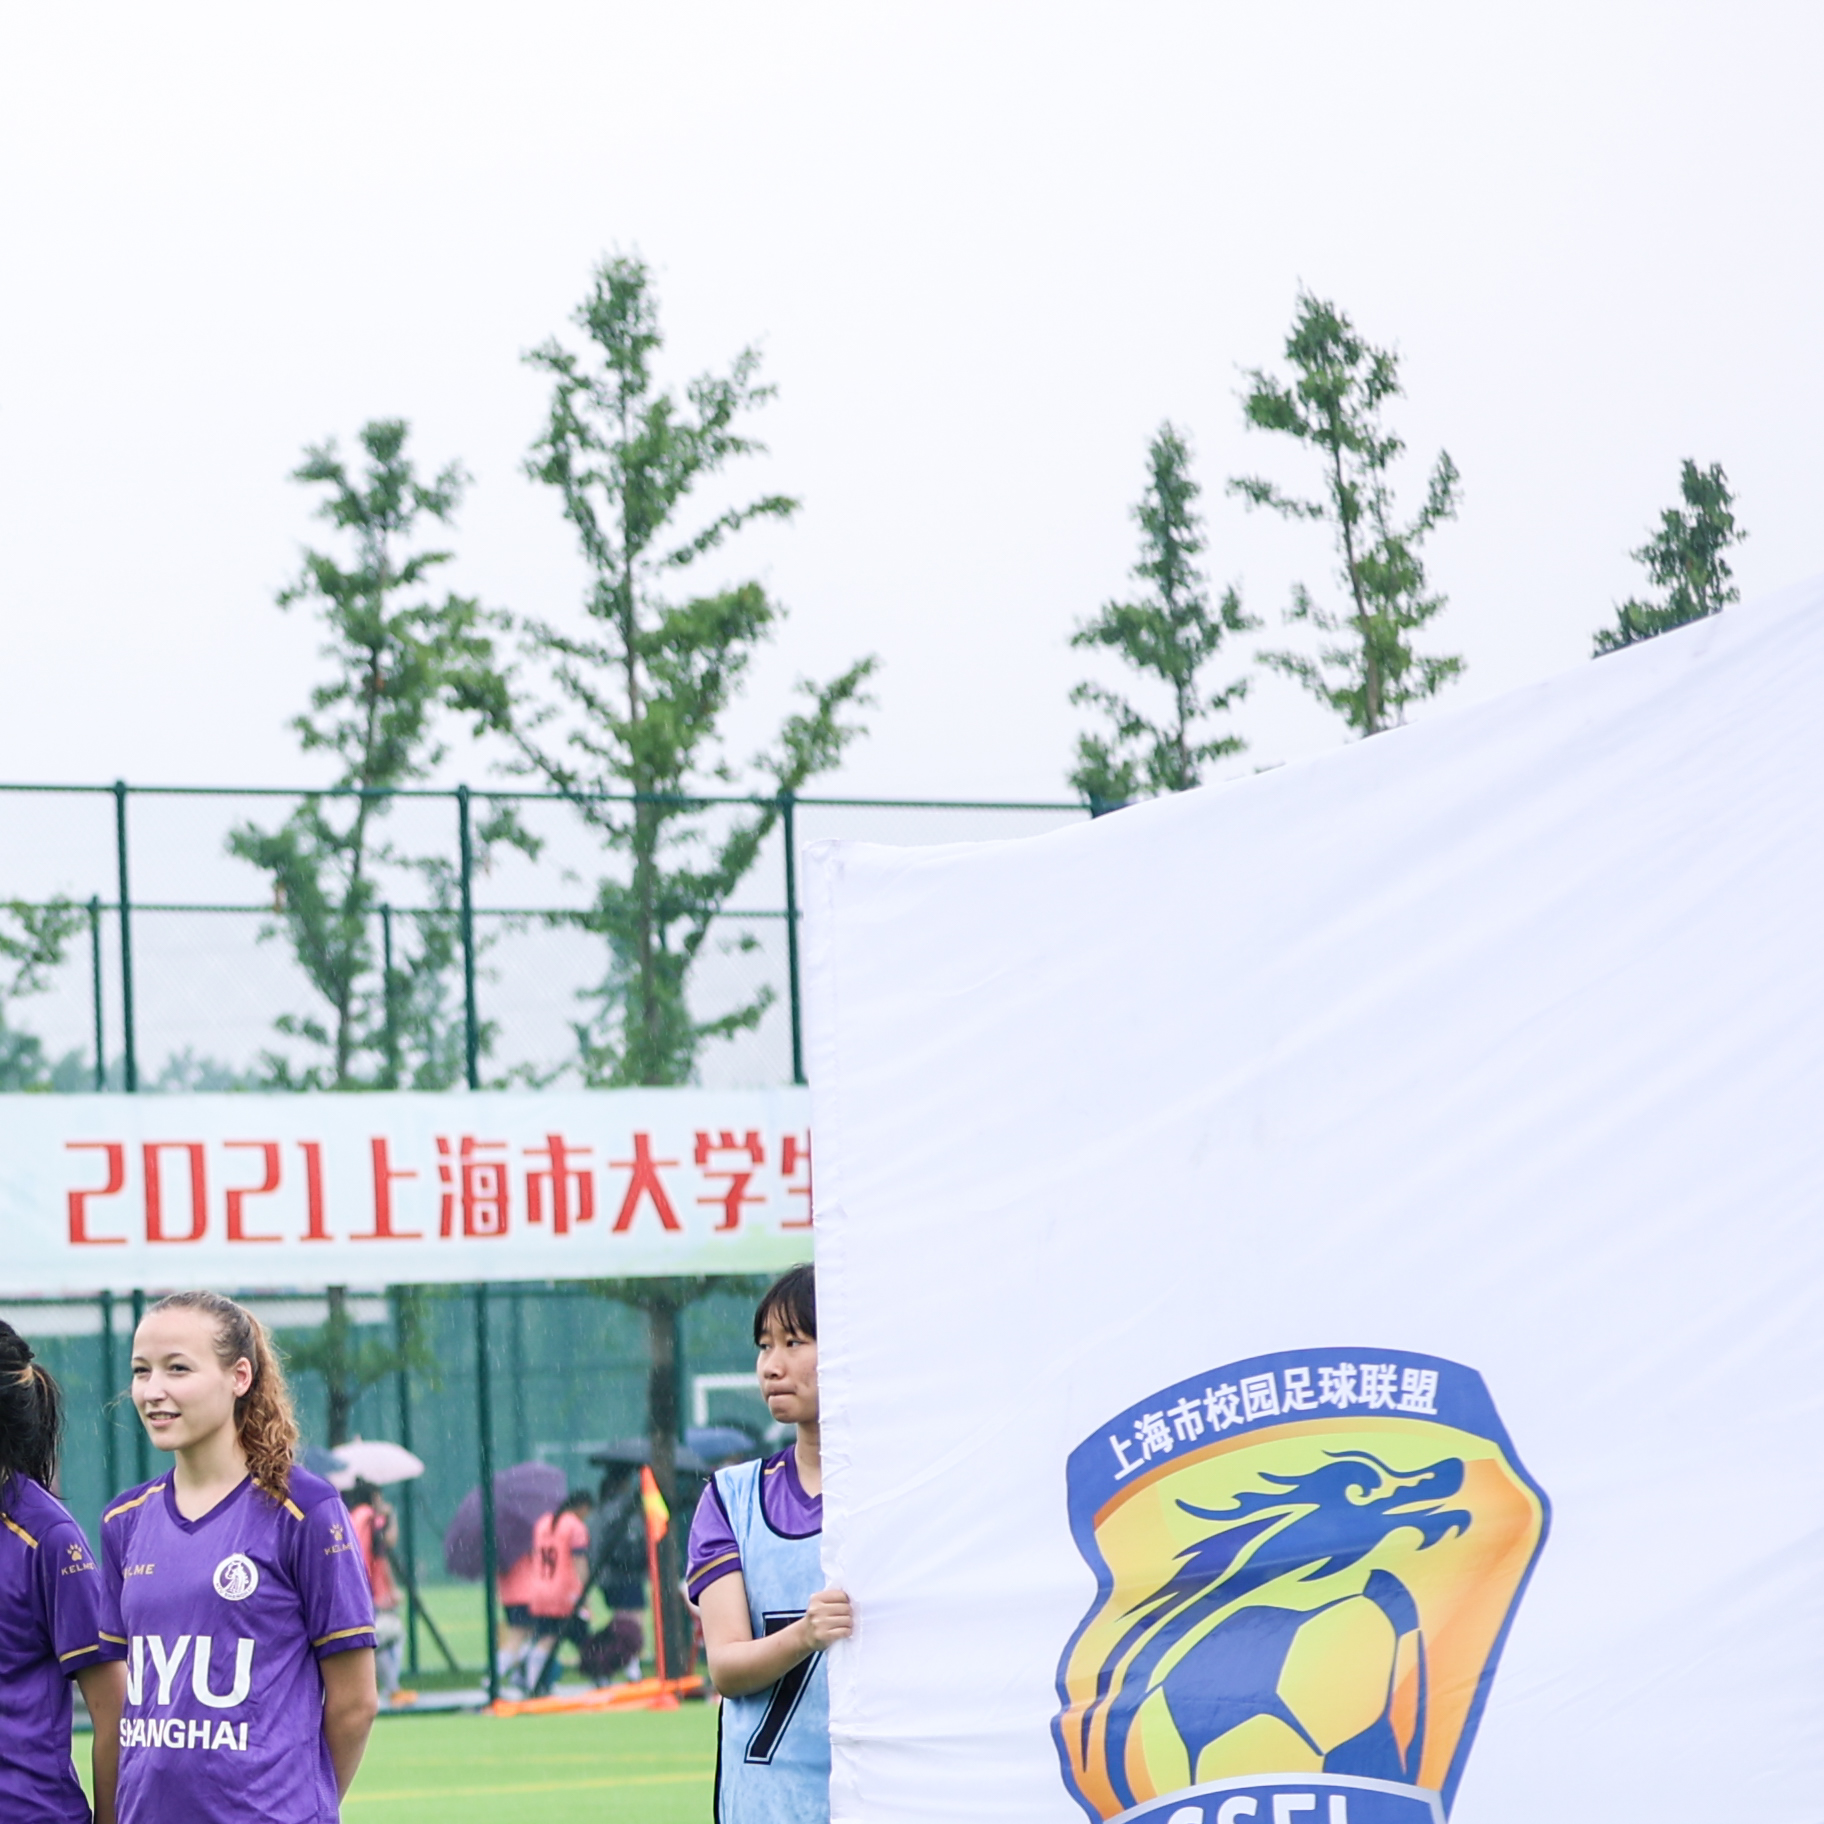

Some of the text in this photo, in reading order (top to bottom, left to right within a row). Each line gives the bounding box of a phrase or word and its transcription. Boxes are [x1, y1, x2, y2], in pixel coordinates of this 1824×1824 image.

[1108, 1362, 1439, 1480] 上海市校园足球联盟
[61, 1562, 95, 1576] KELME
[744, 1609, 824, 1766] 7
